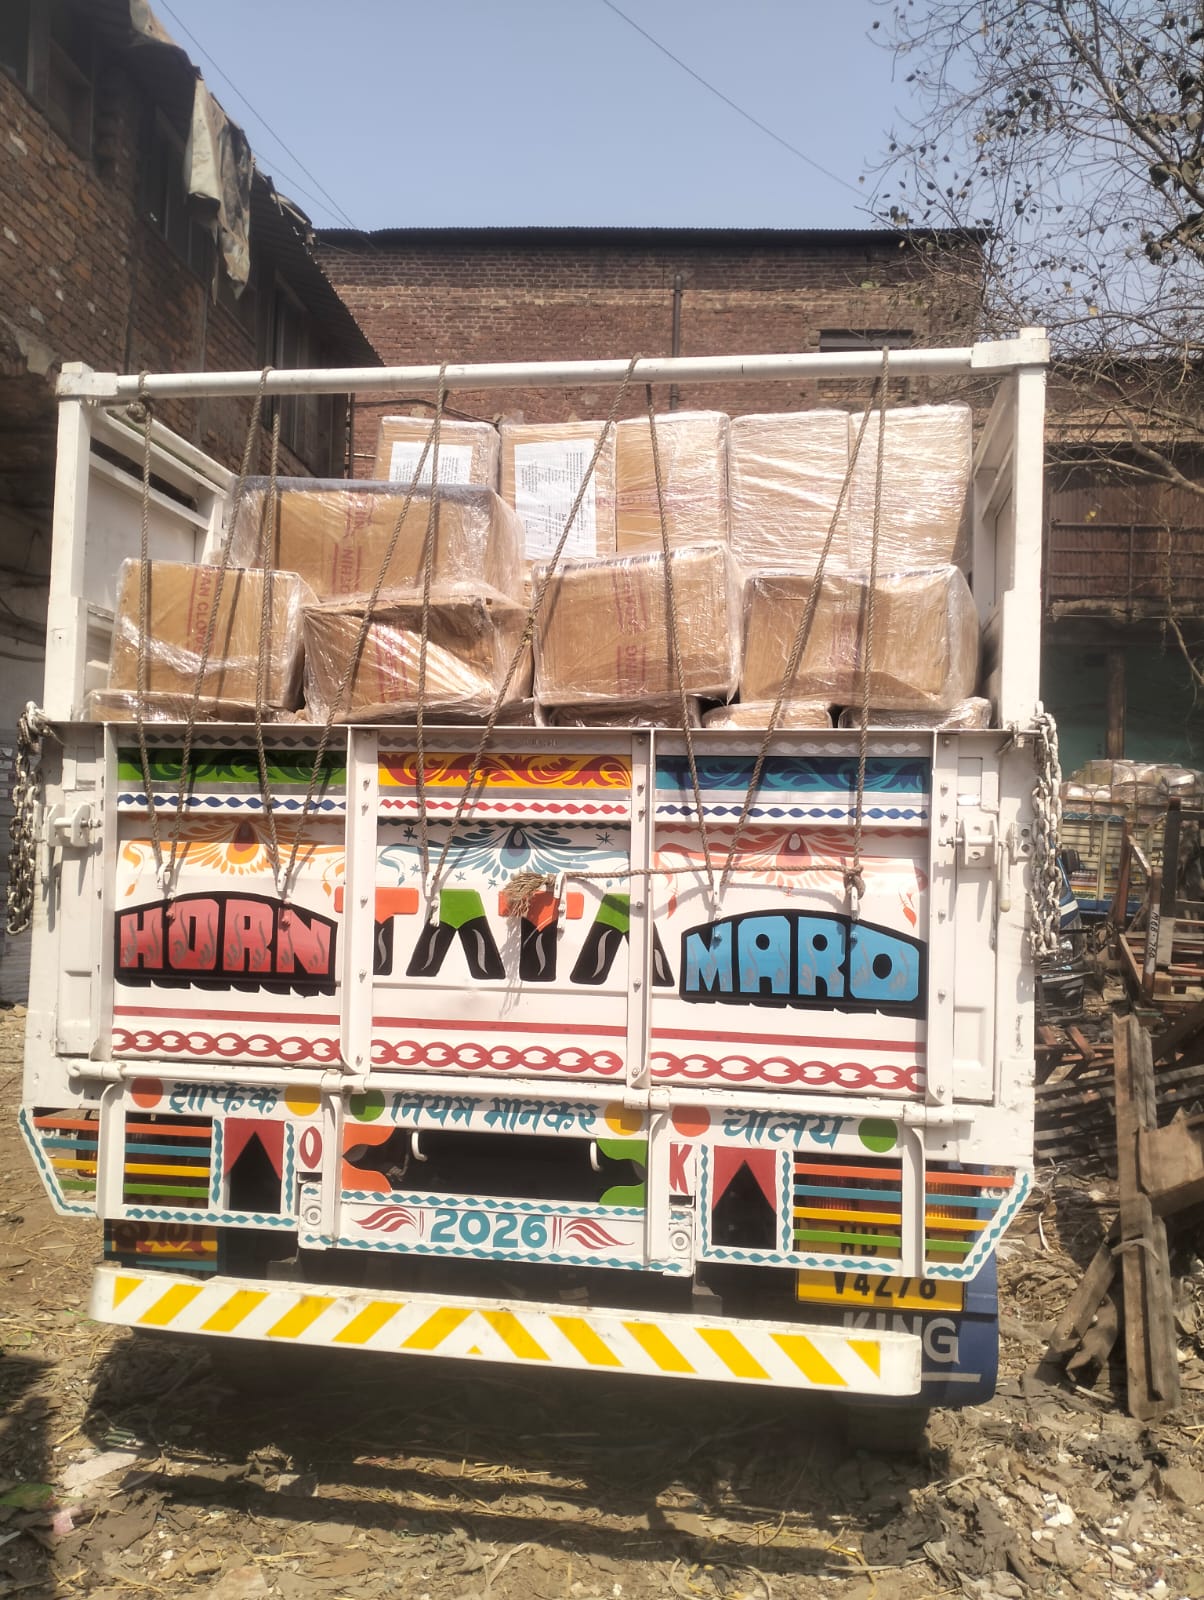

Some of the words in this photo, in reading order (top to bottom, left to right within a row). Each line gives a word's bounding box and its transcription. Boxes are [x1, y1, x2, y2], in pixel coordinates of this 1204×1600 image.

[119, 898, 336, 976] HORN
[334, 886, 676, 988] TATA
[685, 914, 921, 1003] MARO
[390, 1090, 483, 1128] नियम
[484, 1096, 600, 1136] मानकर
[669, 1143, 694, 1195] K
[430, 1207, 548, 1249] 2026
